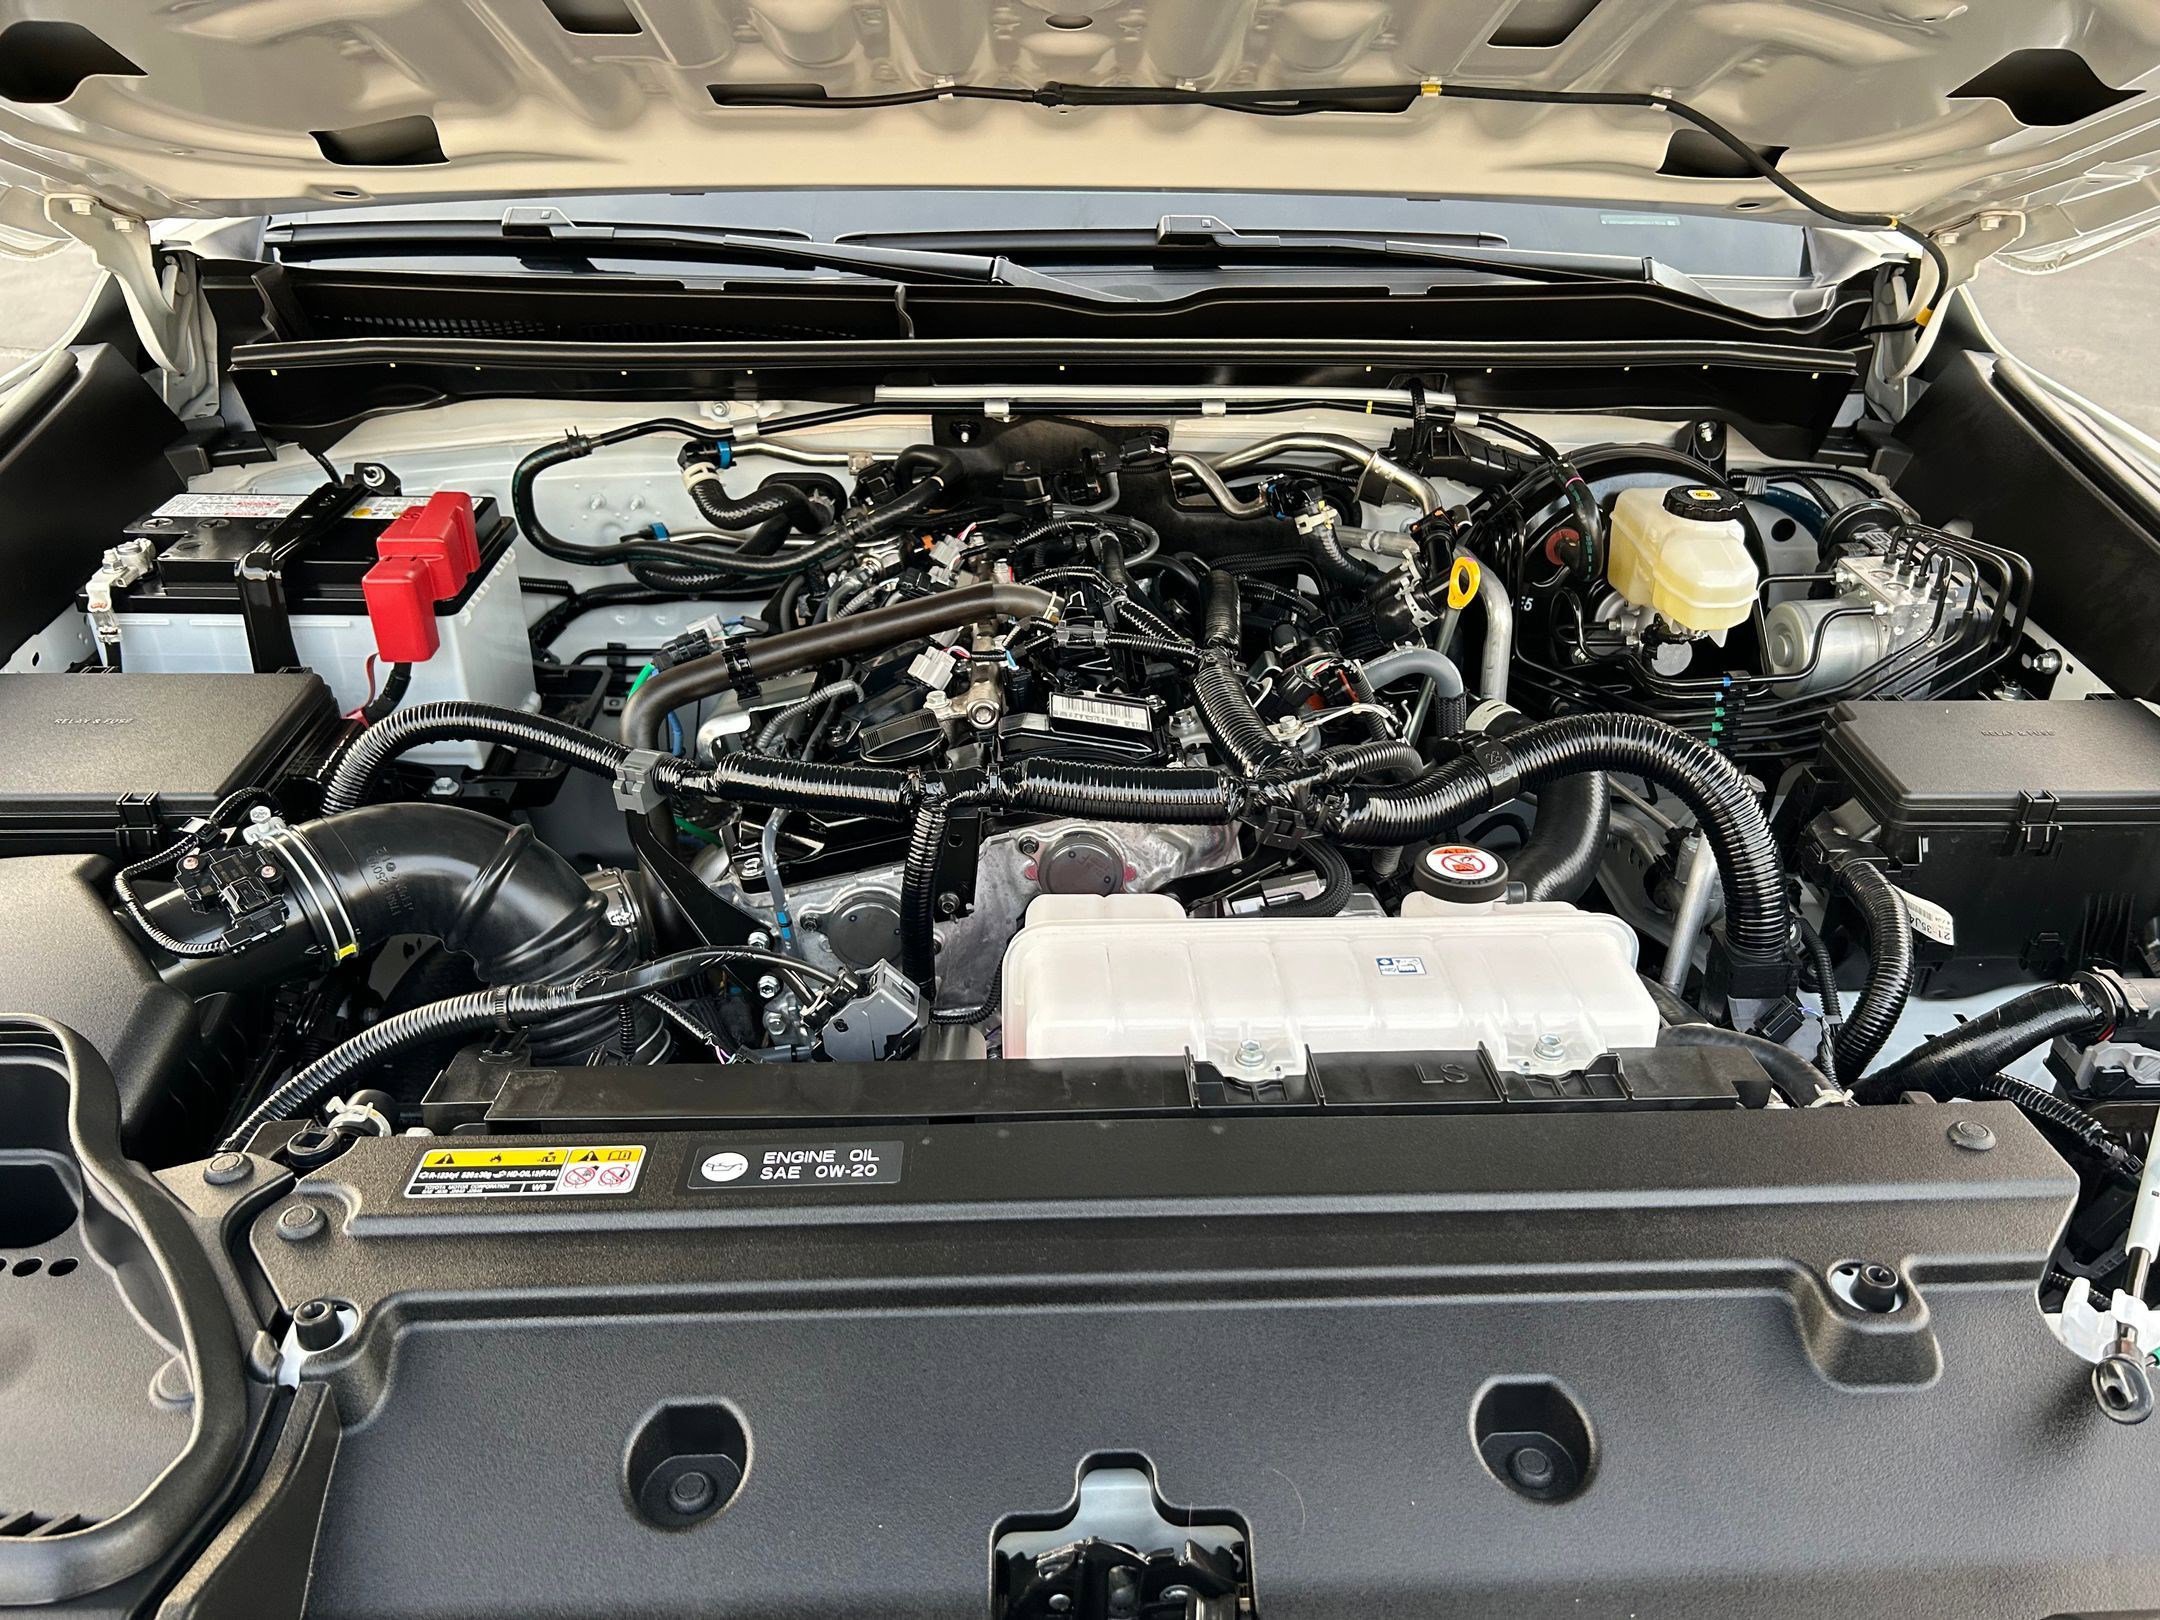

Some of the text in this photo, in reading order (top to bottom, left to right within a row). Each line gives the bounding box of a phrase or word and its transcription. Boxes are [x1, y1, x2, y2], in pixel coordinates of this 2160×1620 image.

[1414, 1063, 1469, 1084] LS
[763, 1149, 880, 1164] ENGINE OIL
[760, 1164, 878, 1180] SAE 0W-20
